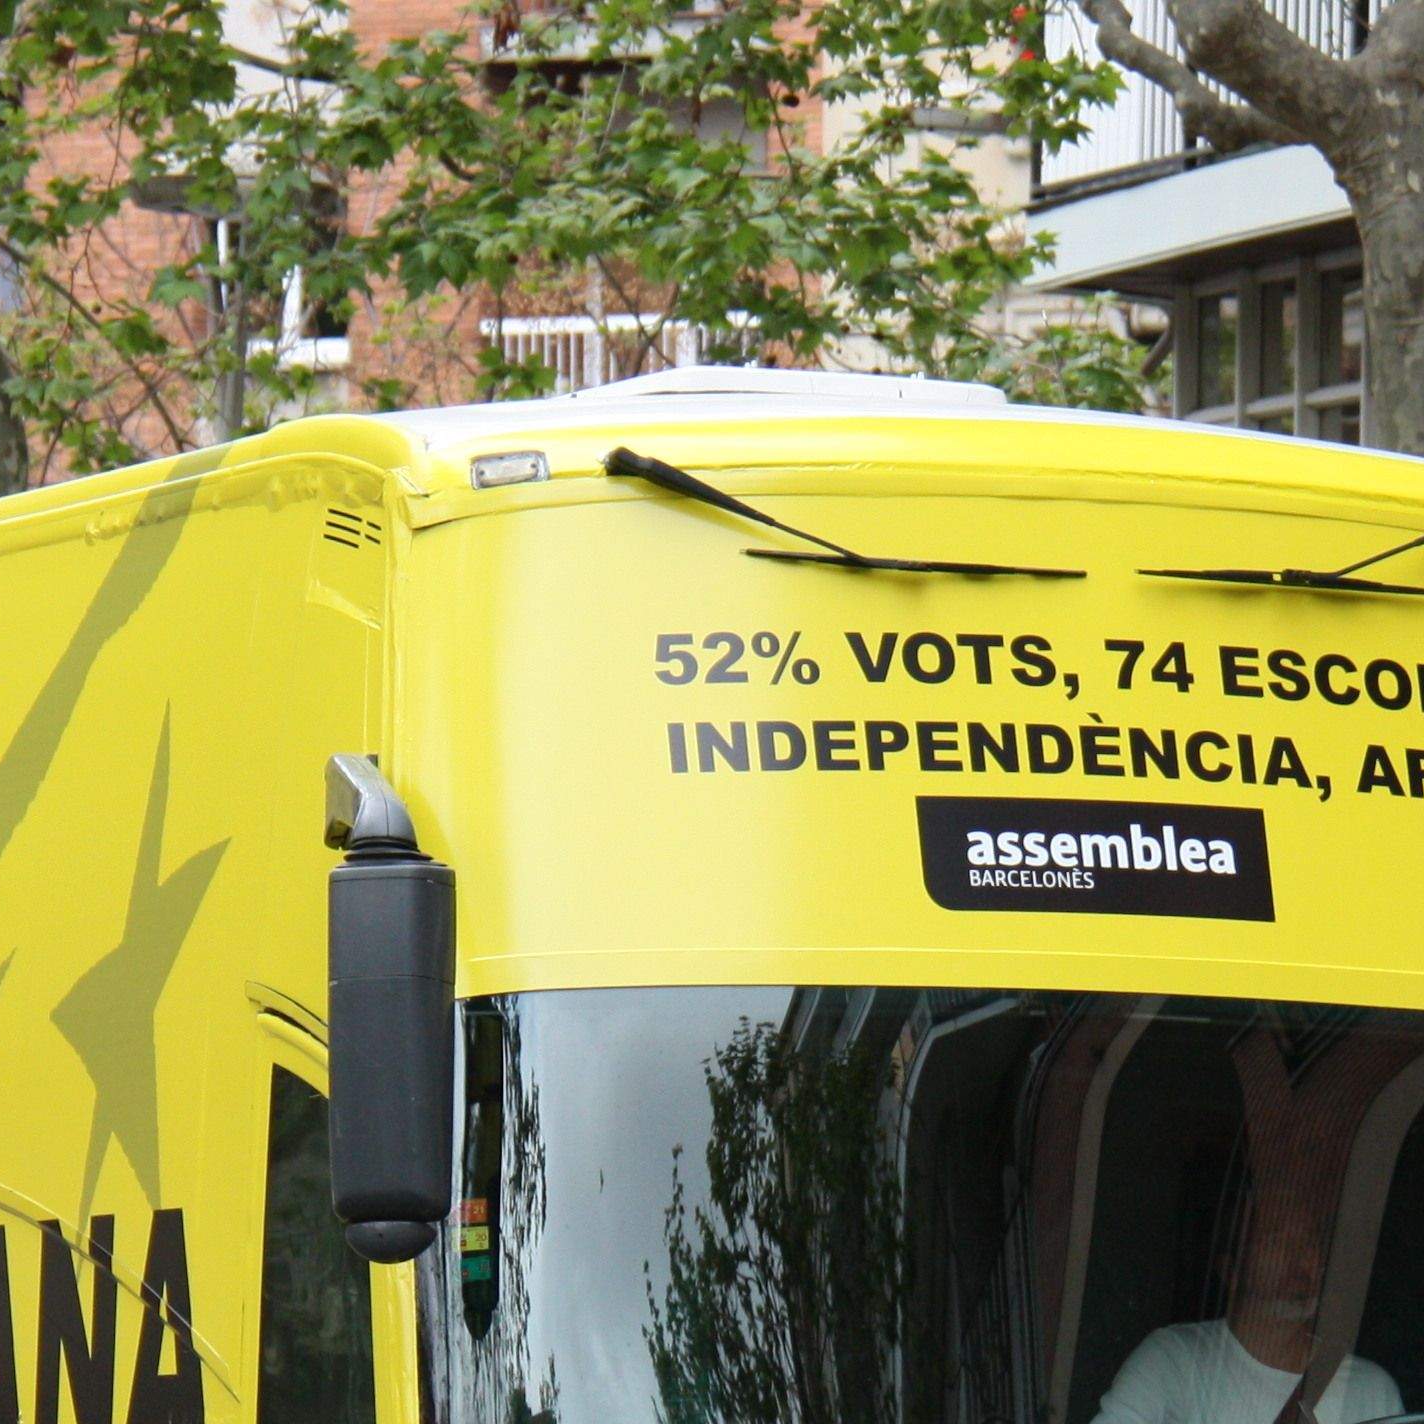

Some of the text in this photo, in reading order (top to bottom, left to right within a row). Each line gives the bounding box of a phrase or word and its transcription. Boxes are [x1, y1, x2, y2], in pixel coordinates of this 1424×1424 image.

[654, 631, 821, 686] 52%
[844, 632, 1081, 701] VOTS,
[1104, 639, 1195, 693] 74
[667, 713, 1332, 803] INDEPENDÈNCIA,
[966, 823, 1237, 875] assemblea
[968, 865, 1096, 889] BARCELONÈS
